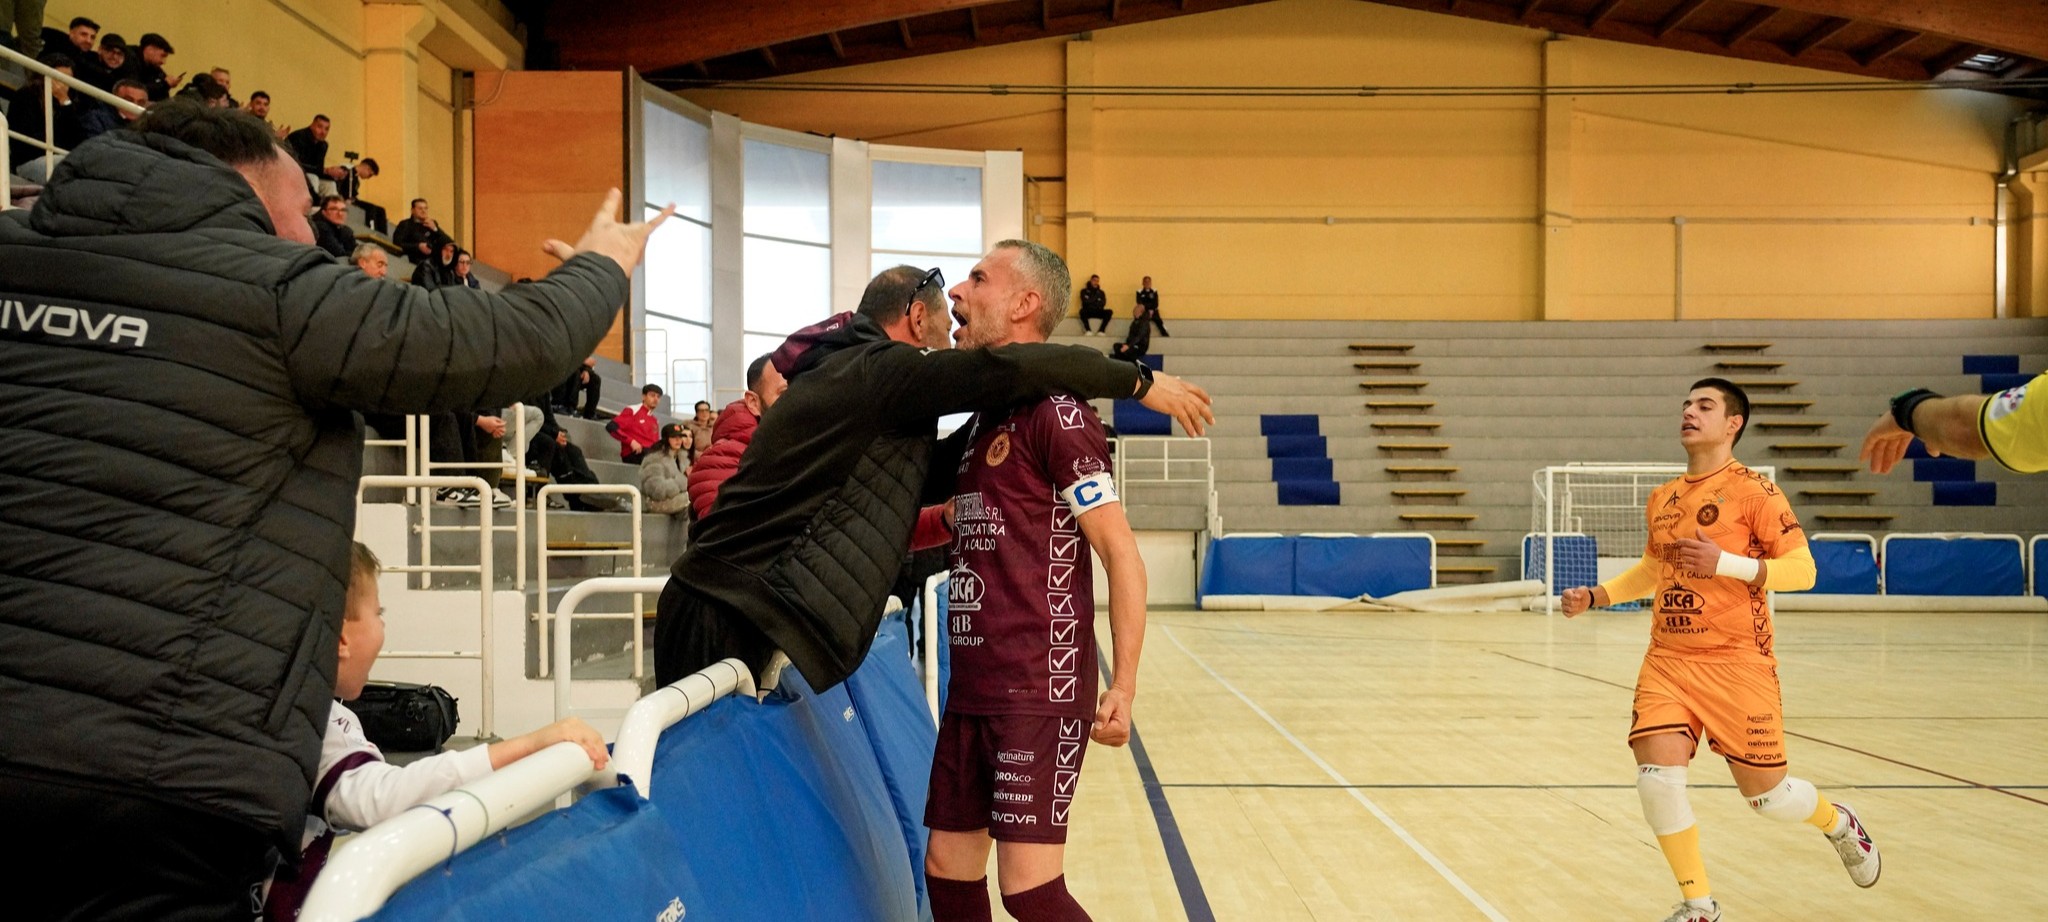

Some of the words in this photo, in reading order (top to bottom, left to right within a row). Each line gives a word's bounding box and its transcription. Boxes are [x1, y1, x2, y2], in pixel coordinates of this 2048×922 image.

[0, 299, 148, 347] IVOVA
[1073, 480, 1103, 506] C
[961, 523, 1006, 537] ZINCATURA
[965, 540, 969, 550] A
[970, 538, 996, 551] CALDO
[952, 635, 985, 646] GROUP
[997, 751, 1034, 762] Agrinature
